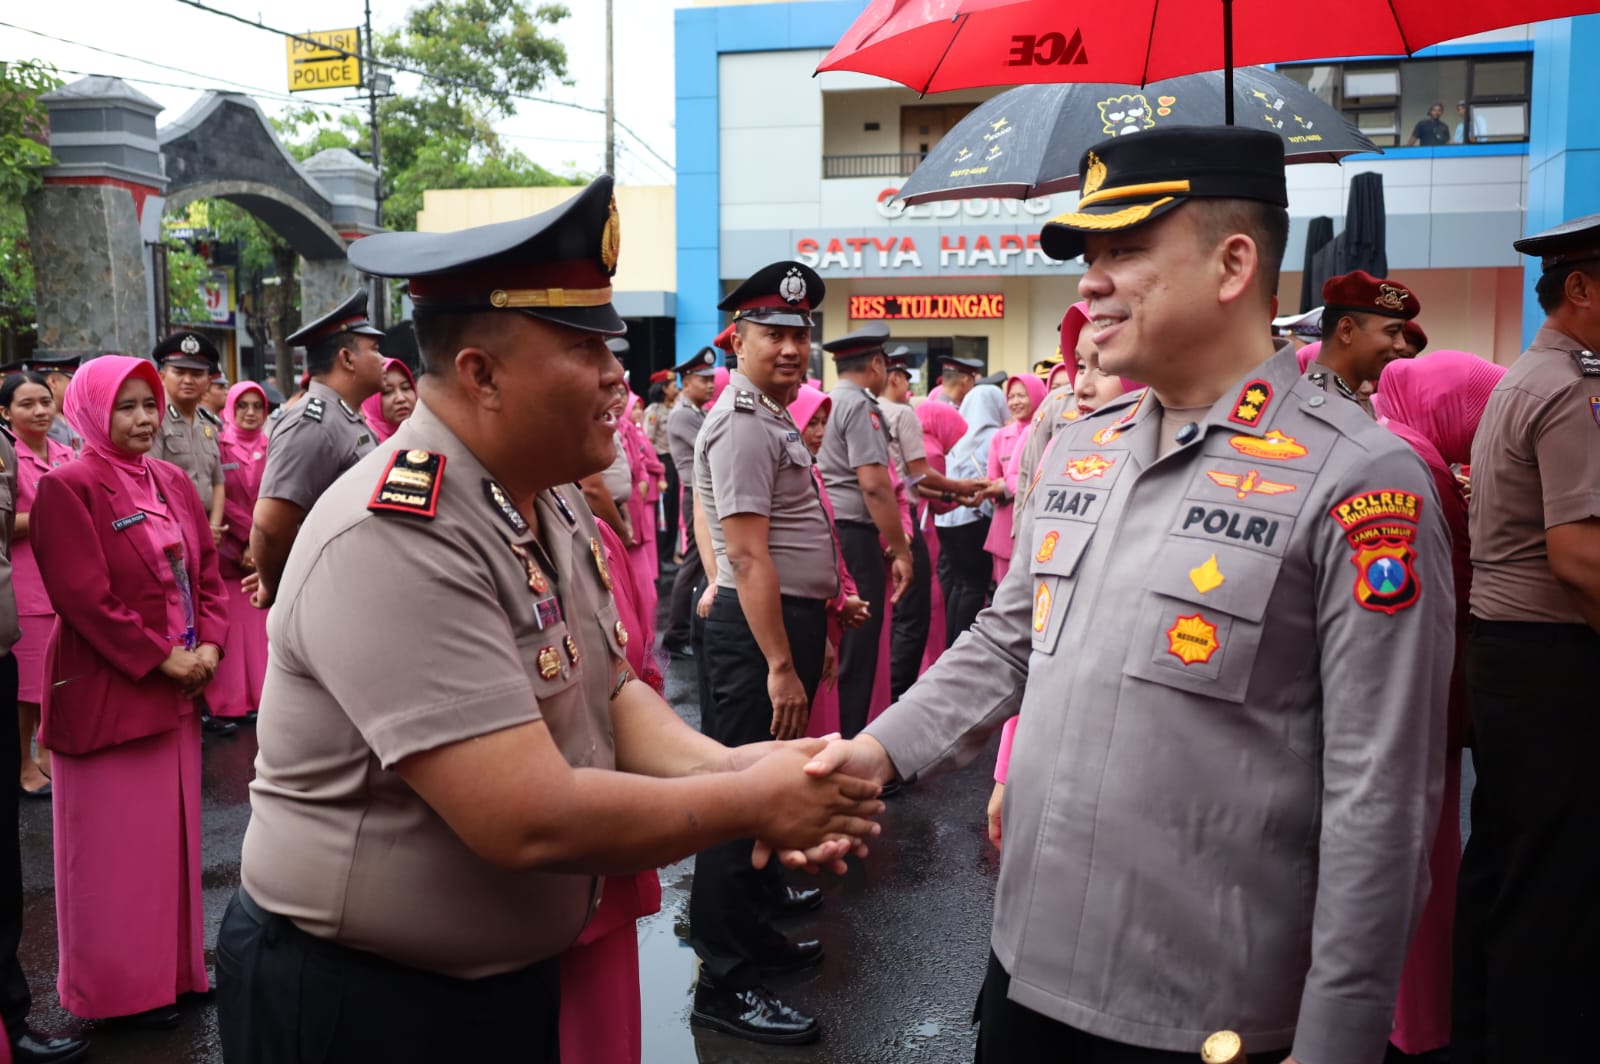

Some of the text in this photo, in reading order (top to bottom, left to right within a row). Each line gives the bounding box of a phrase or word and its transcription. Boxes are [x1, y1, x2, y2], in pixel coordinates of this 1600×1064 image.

[293, 34, 350, 54] POLISI
[294, 65, 352, 84] POLICE
[795, 236, 922, 269] SATYA
[1044, 489, 1097, 516] TAAT
[1339, 492, 1416, 517] POLRES
[1343, 504, 1416, 525] TULUNGAGUNG
[1182, 506, 1279, 547] POLRI
[1354, 527, 1411, 542] JAWA TIMUR
